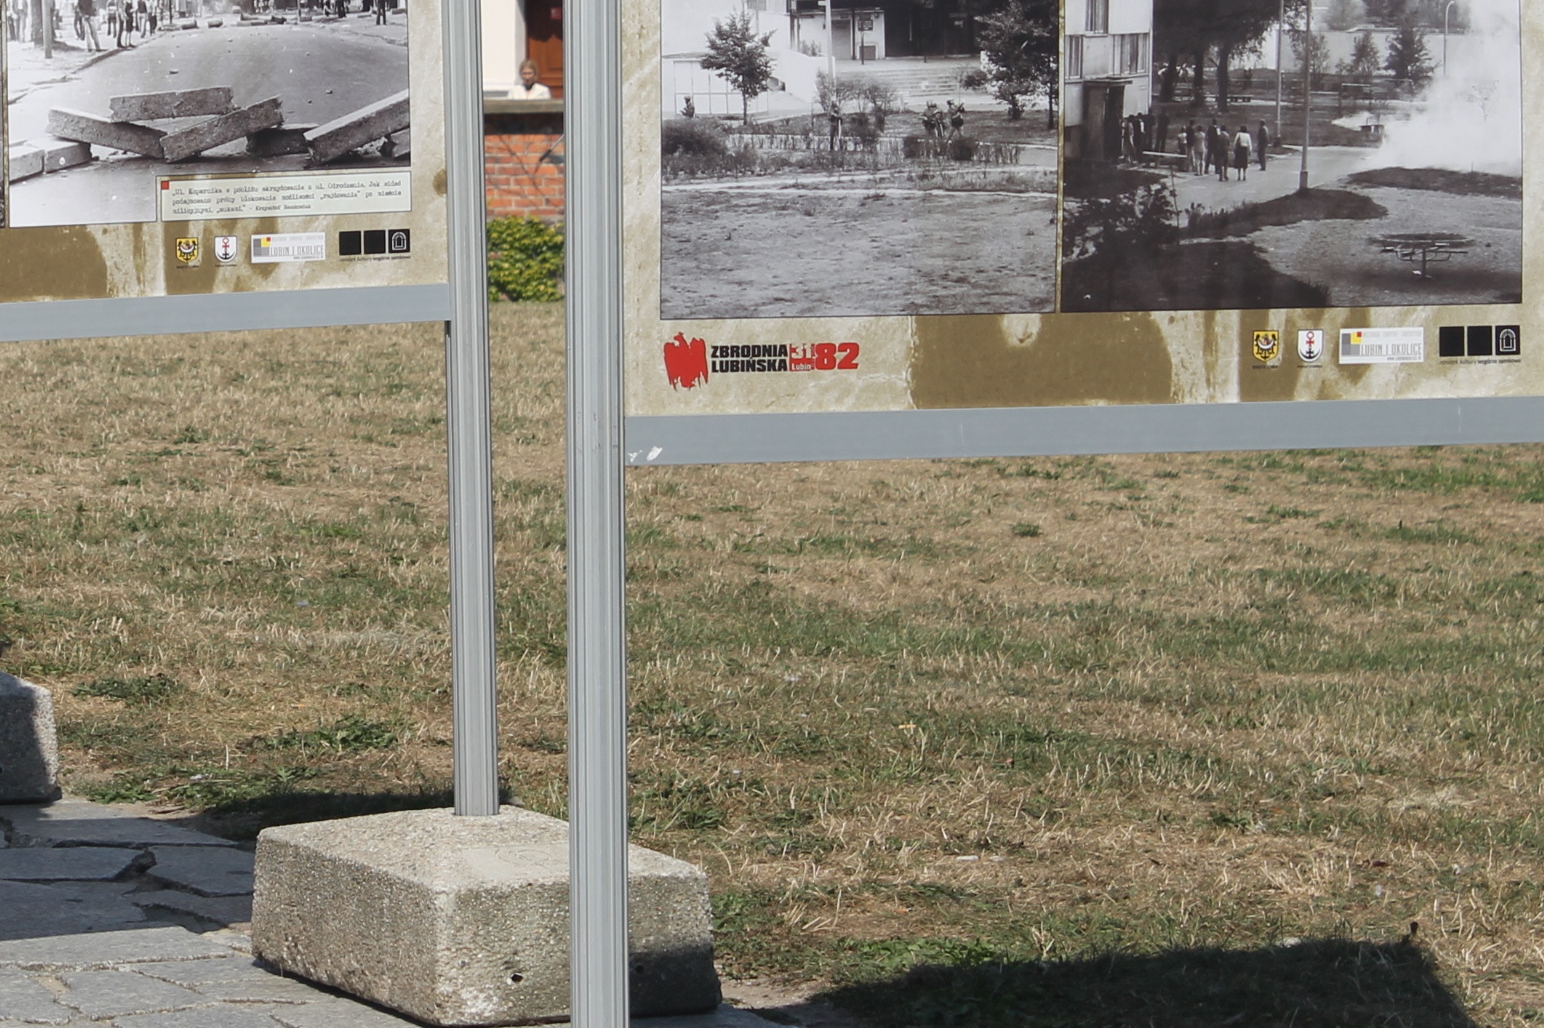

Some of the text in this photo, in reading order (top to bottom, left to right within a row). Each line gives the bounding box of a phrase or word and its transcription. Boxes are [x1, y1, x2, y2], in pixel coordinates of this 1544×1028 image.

[711, 344, 788, 358] ZBRODNIA
[815, 342, 860, 370] 82
[711, 357, 788, 373] LUBIŃSKA
